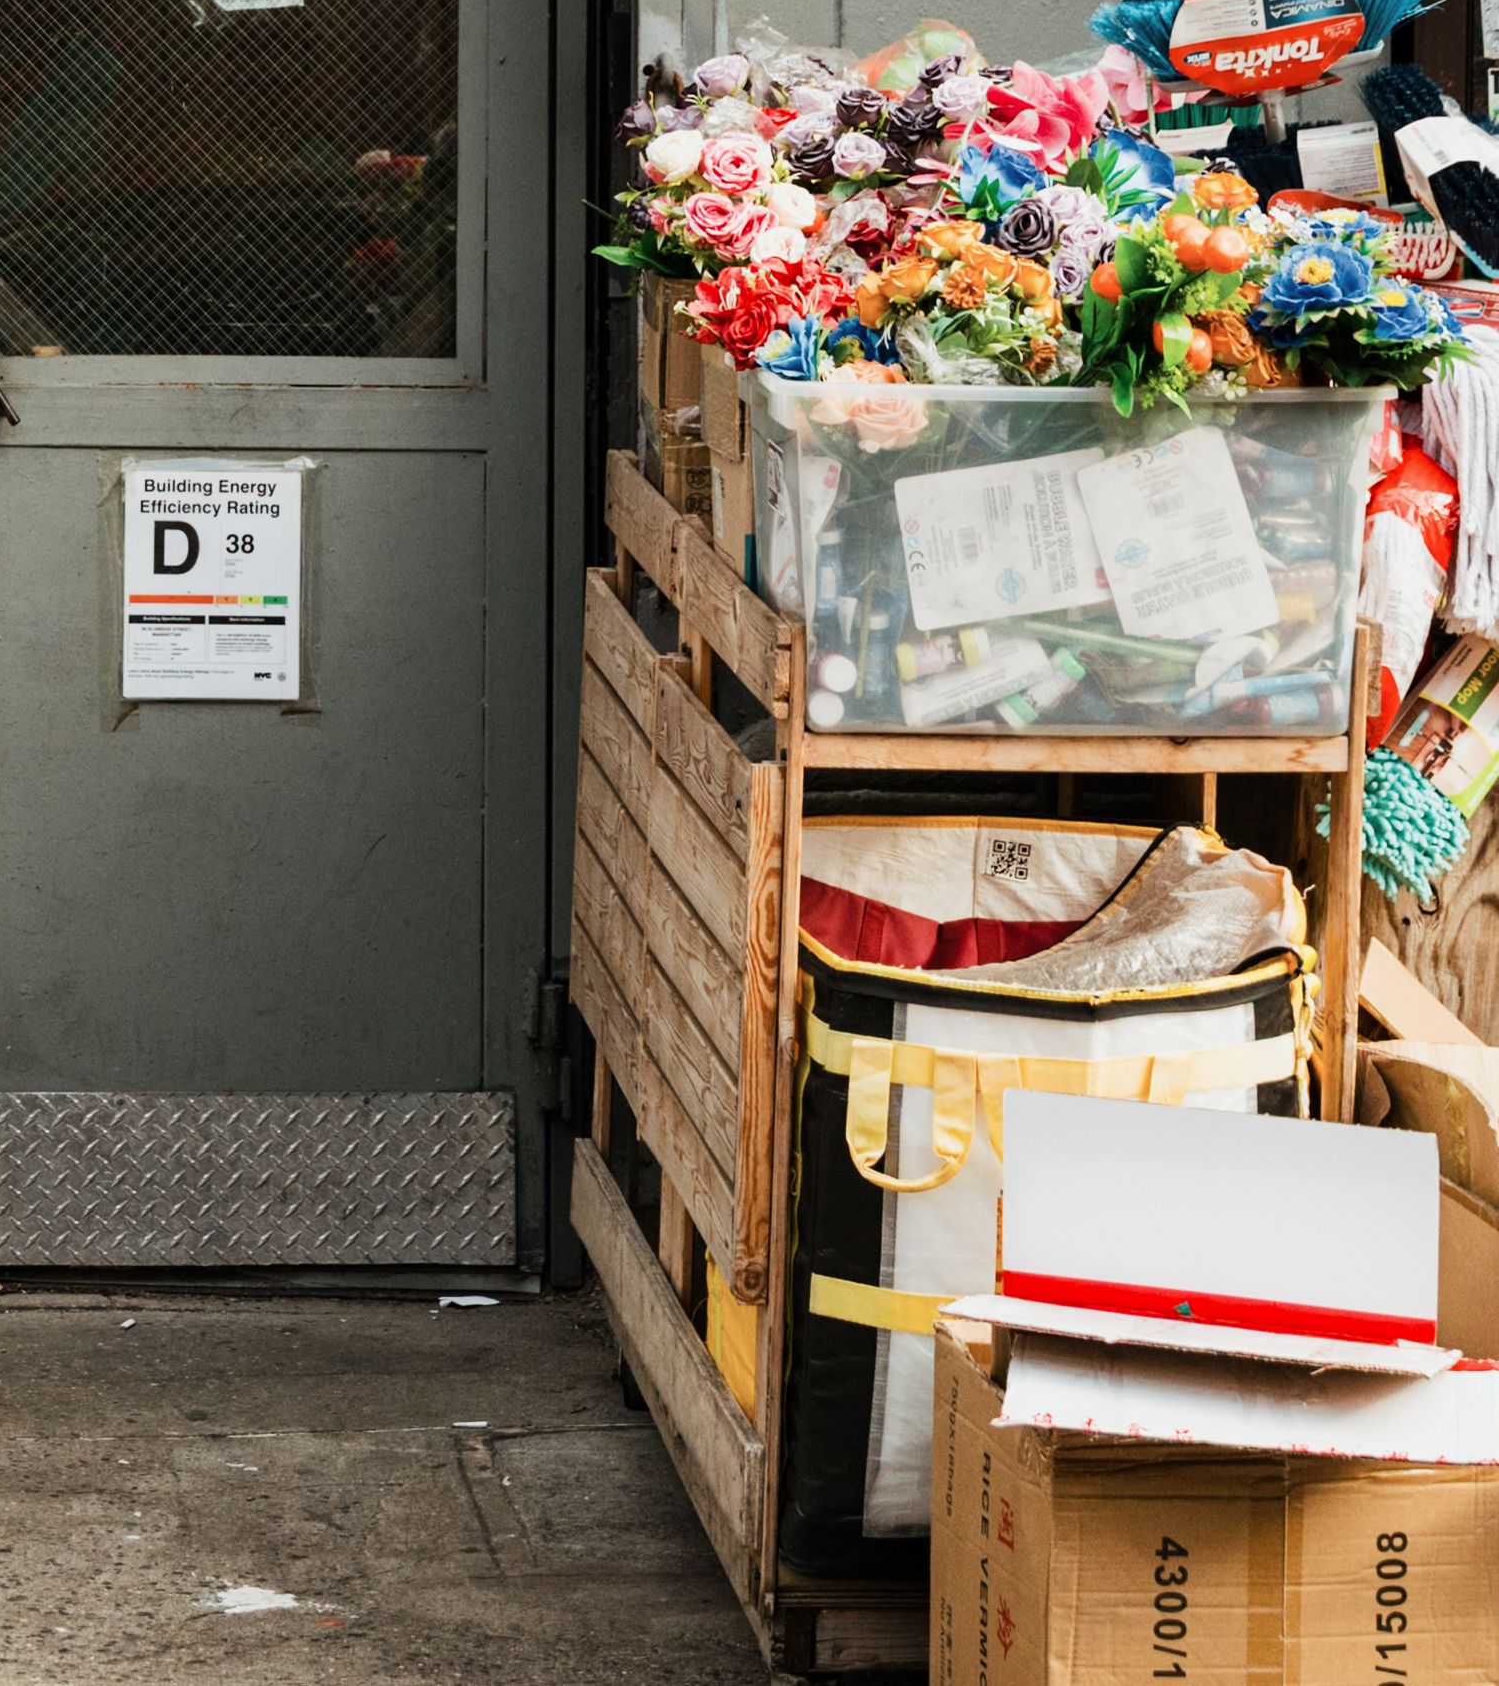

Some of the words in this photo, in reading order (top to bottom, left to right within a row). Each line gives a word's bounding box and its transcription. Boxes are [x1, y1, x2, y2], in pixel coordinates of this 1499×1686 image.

[1214, 36, 1326, 73] Tonkita
[144, 478, 213, 496] Building
[219, 479, 277, 497] Energy
[140, 500, 222, 518] Efficiency
[227, 500, 281, 518] Rating
[153, 520, 201, 575] D
[225, 533, 256, 554] 38
[1454, 680, 1483, 707] Mop
[979, 1452, 993, 1539] RICE
